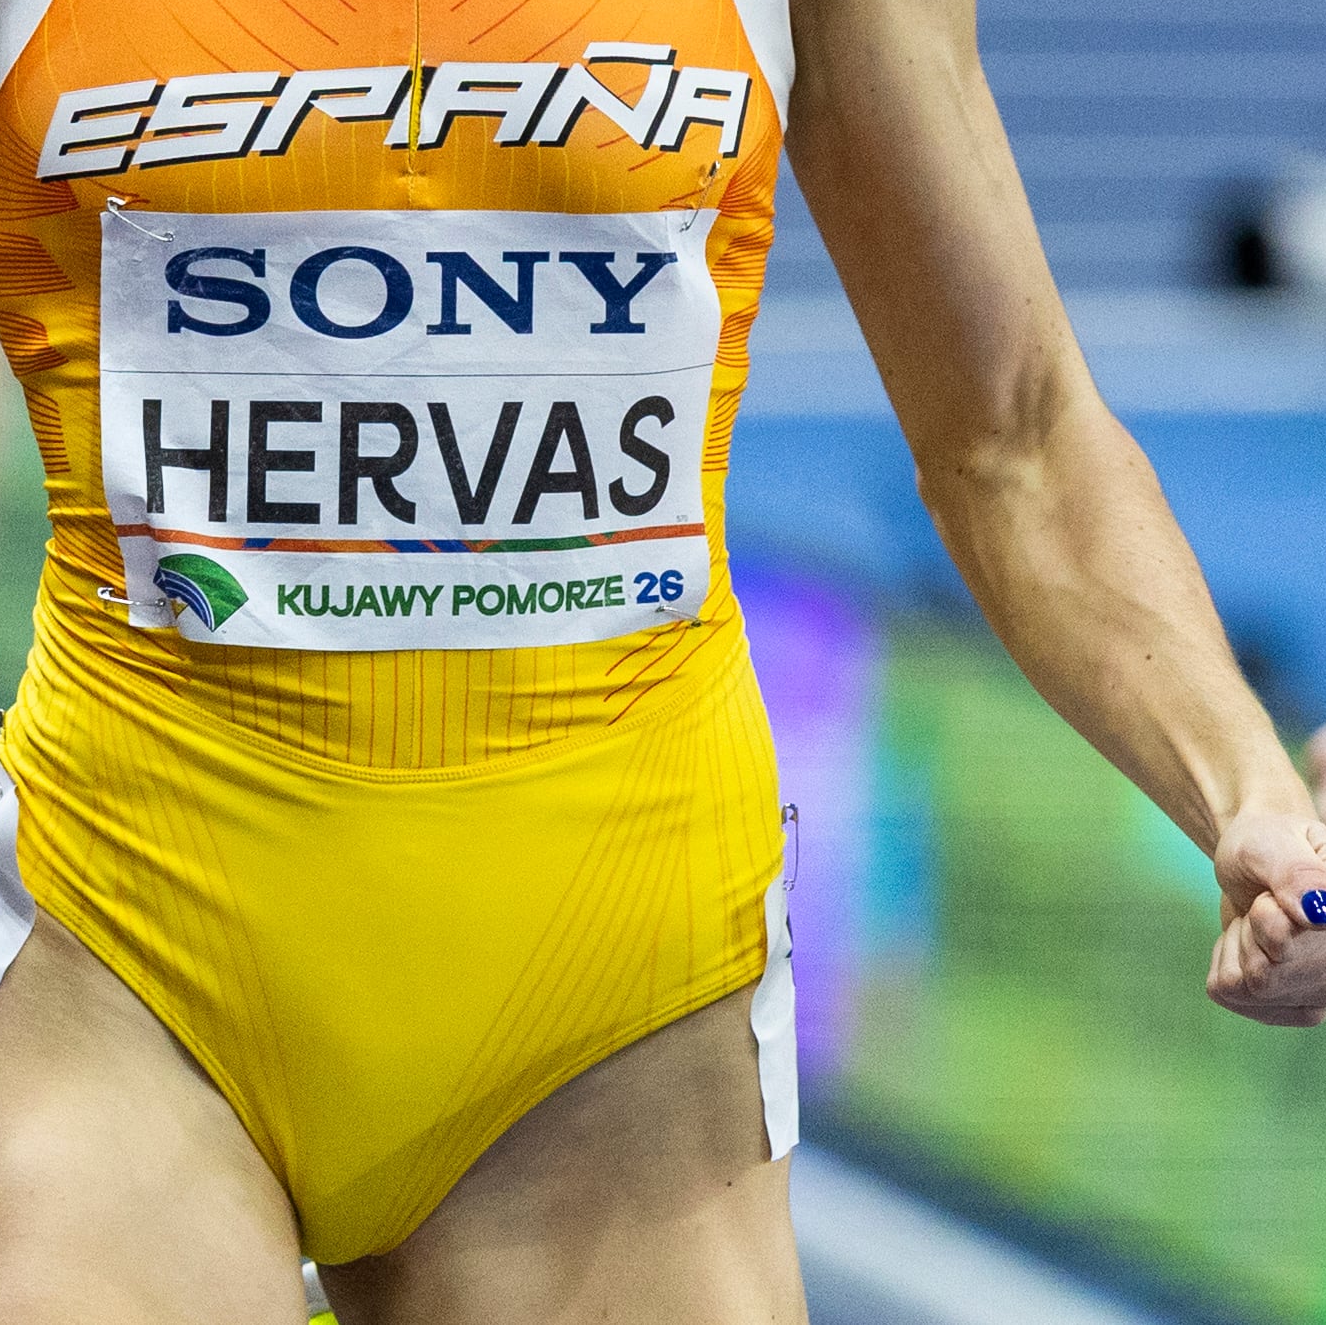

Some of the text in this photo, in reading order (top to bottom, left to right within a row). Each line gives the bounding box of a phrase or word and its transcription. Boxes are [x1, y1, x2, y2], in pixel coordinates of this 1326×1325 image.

[36, 42, 753, 182] ESPAÑA
[164, 246, 678, 339] SONY
[143, 395, 676, 526] HERVAS
[276, 569, 685, 618] KUJAWY POMORZE 26
